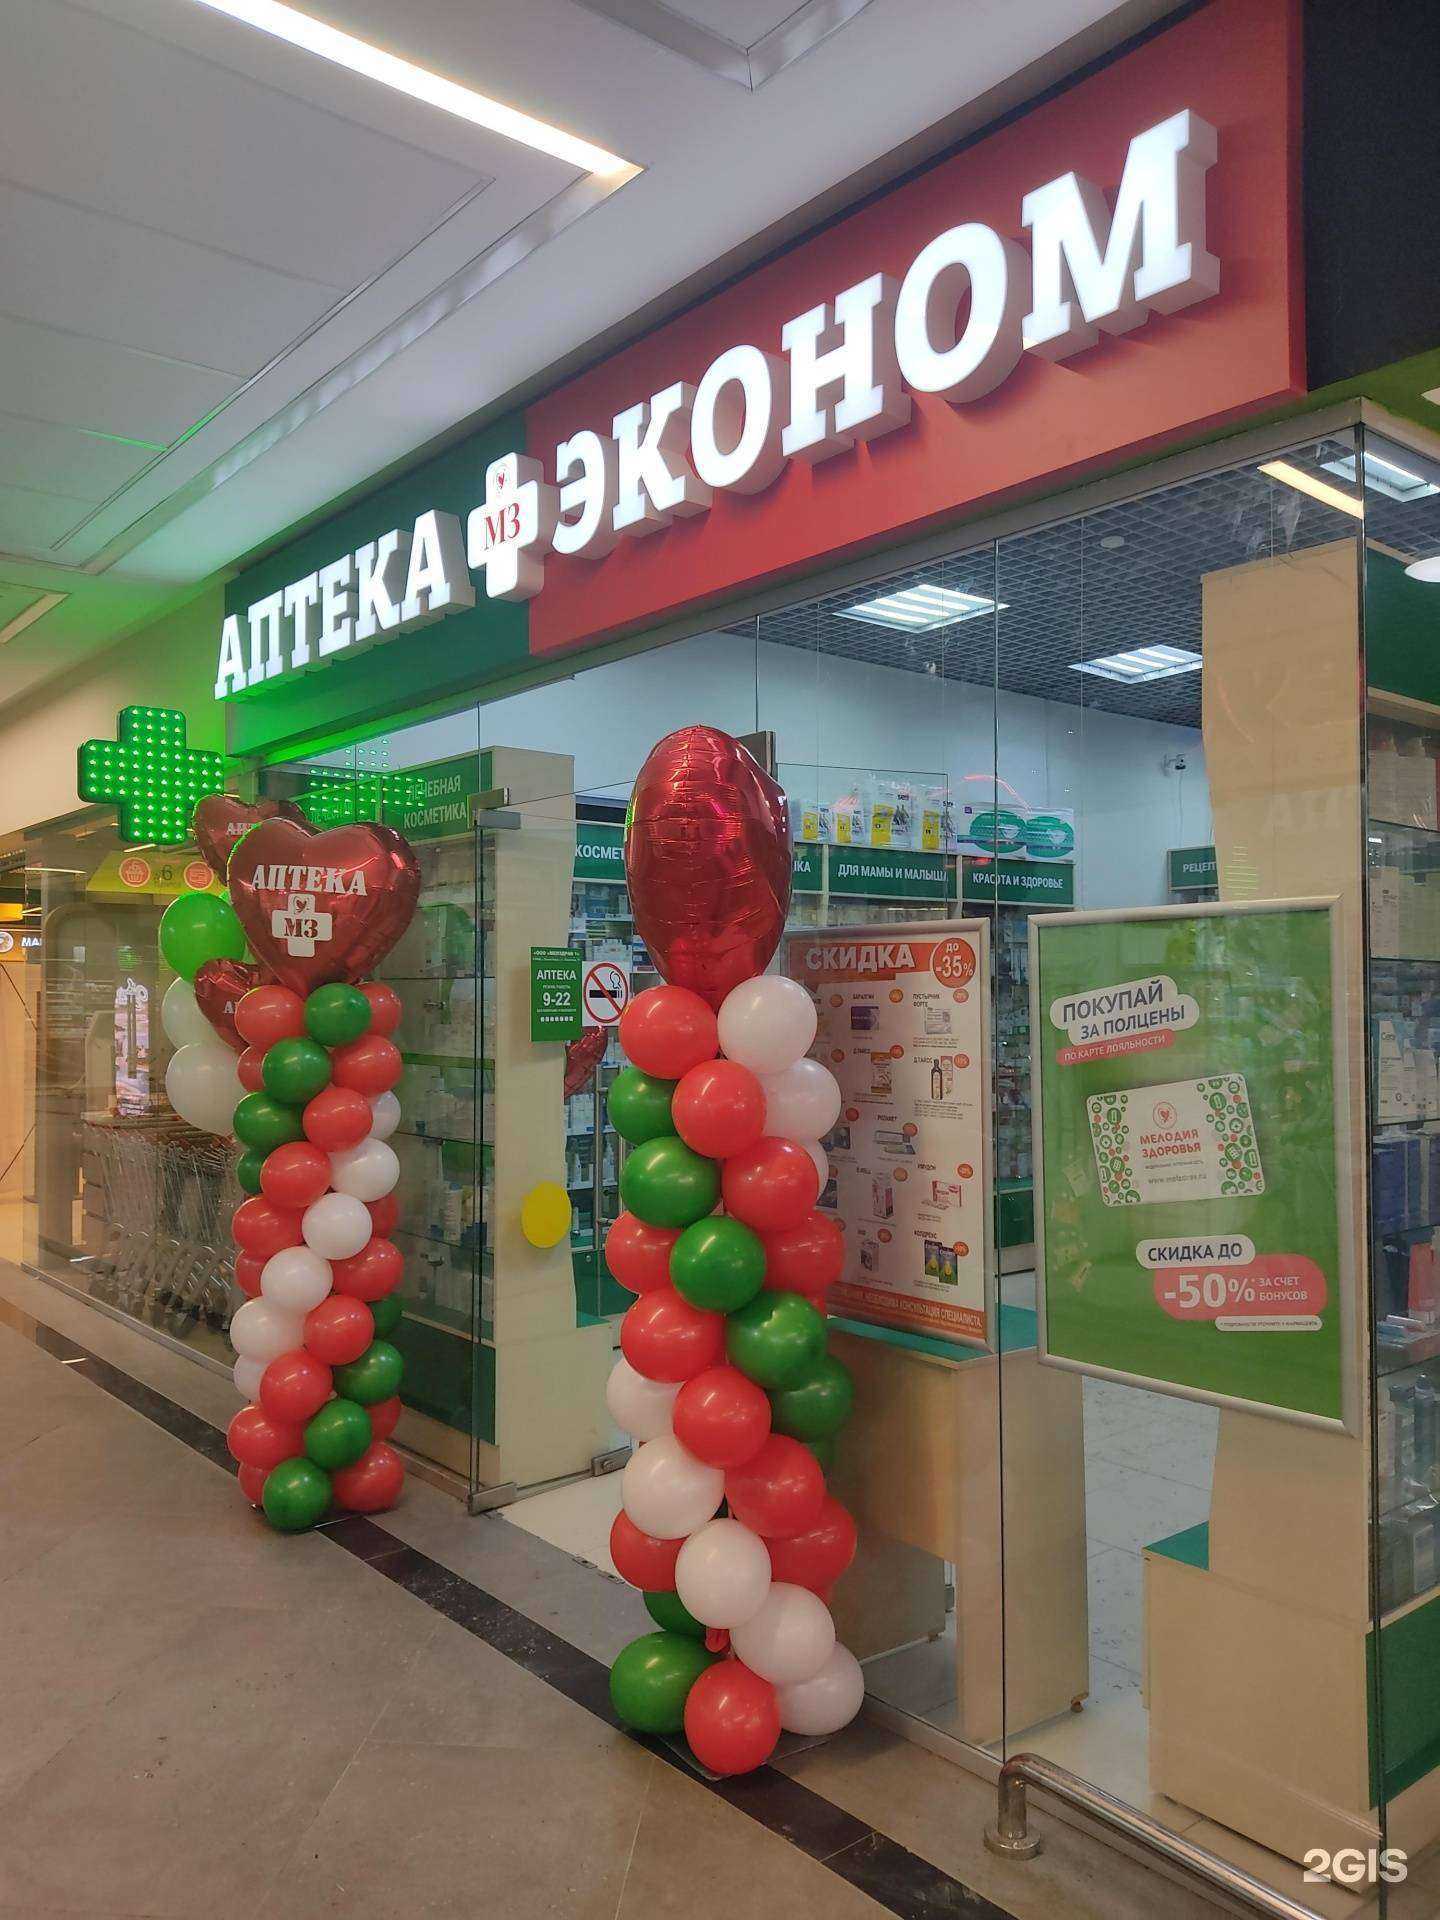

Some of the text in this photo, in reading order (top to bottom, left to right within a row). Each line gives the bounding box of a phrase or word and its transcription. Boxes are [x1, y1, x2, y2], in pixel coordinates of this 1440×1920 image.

[215, 510, 450, 700] АПТЕКА
[553, 108, 1192, 555] ЭКОНОМ
[404, 802, 467, 829] КОСМЕТИКА
[838, 863, 858, 877] ДЛЯ
[862, 866, 893, 878] МАМЫ
[896, 868, 902, 878] И
[252, 865, 367, 896] АПТЕКА
[973, 872, 1063, 889] КРАСОТА И ЗДОРОВЬЕ
[946, 943, 959, 953] ДО
[805, 944, 915, 972] СКИДКА
[536, 969, 577, 980] АПТЕКА
[543, 992, 571, 1006] 9-22
[1063, 979, 1163, 1023] ПОКУПАЙ
[1081, 1004, 1185, 1040] ЗА ПОЛЦЕНЫ
[1064, 1034, 1165, 1061] ПО КАРТЕ ЛОЯЛЬНОСТИ
[1140, 1129, 1199, 1144] МЕЛОДИЯ
[1142, 1143, 1201, 1159] ЗДОРОВЬЯ
[1148, 1243, 1242, 1261] СКИДКА ДО
[1259, 1276, 1300, 1287] ЗА СЧЕТ
[1259, 1291, 1308, 1301] БОНУСОВ
